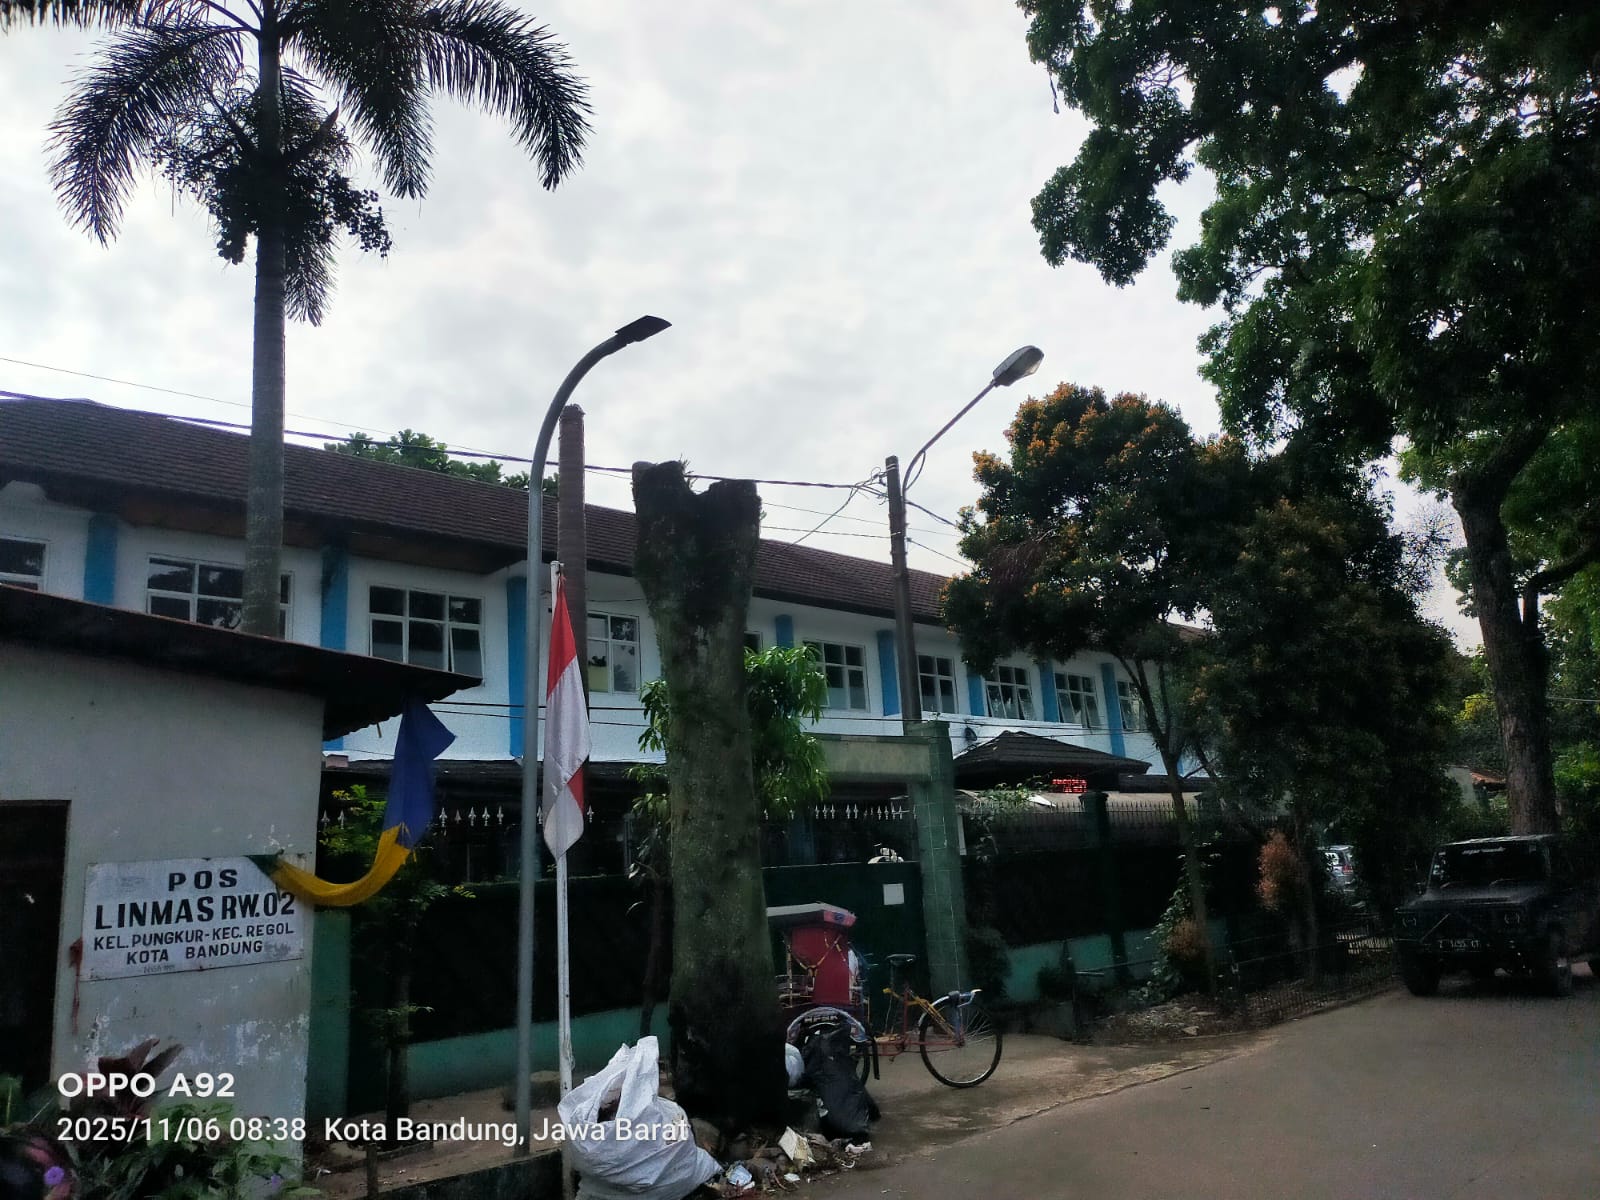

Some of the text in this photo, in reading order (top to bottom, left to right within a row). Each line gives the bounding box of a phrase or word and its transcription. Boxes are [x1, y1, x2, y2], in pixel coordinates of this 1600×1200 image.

[168, 868, 237, 892] POS
[95, 891, 295, 930] LINMAS RW.02
[126, 940, 263, 966] KOTA BANDUNG
